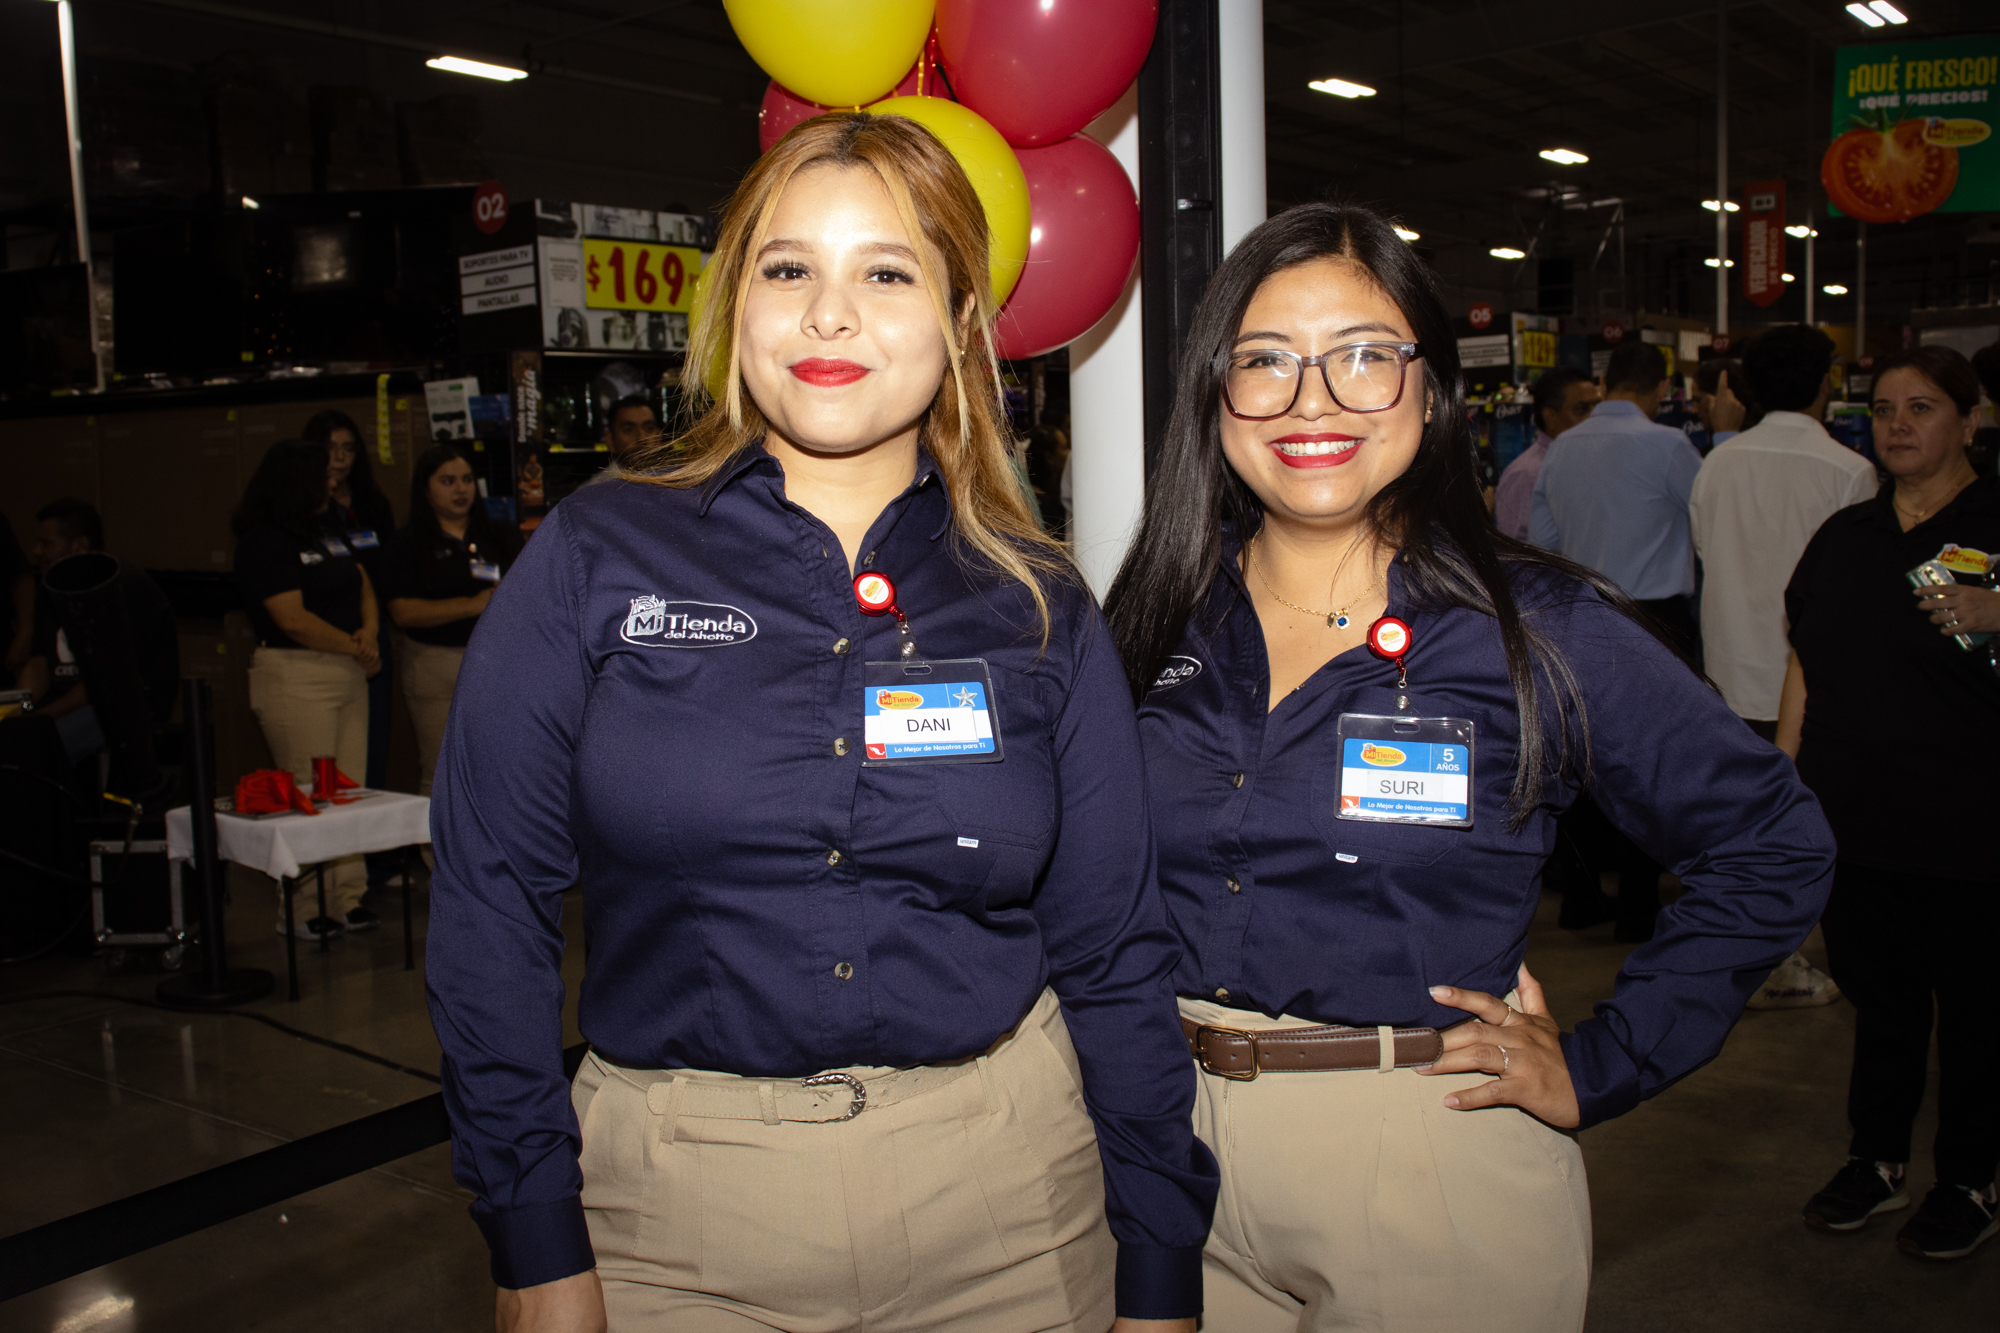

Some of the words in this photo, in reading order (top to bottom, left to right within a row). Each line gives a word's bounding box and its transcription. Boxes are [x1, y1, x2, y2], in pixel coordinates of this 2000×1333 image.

[1847, 55, 1900, 98] ¡QUÉ
[1904, 56, 1998, 90] FRESCO!
[1905, 89, 1989, 106] PRECIOS!
[477, 193, 506, 222] 02
[1768, 226, 1778, 267] PRECIO
[500, 252, 518, 262] PARA
[1748, 220, 1768, 295] VERIFICADOR
[484, 274, 509, 286] AUDIO
[587, 247, 684, 306] $169
[477, 293, 520, 307] PANTALLAS
[1470, 308, 1491, 324] 05
[1603, 325, 1623, 339] 06
[1713, 337, 1730, 349] 07
[523, 368, 542, 431] magia
[634, 613, 663, 634] Mi
[664, 613, 747, 634] Tienda
[663, 629, 687, 639] del
[687, 630, 735, 641] Ahorro
[893, 696, 920, 704] Tienda
[906, 718, 951, 732] DANI
[903, 746, 922, 754] Mejor
[963, 743, 978, 751] para
[1376, 751, 1402, 760] Tienda
[1442, 748, 1455, 762] 5
[1436, 762, 1460, 771] AÑOS
[1380, 780, 1424, 795] SURI
[1376, 802, 1394, 810] Mejor
[1404, 804, 1432, 812] Nosotros
